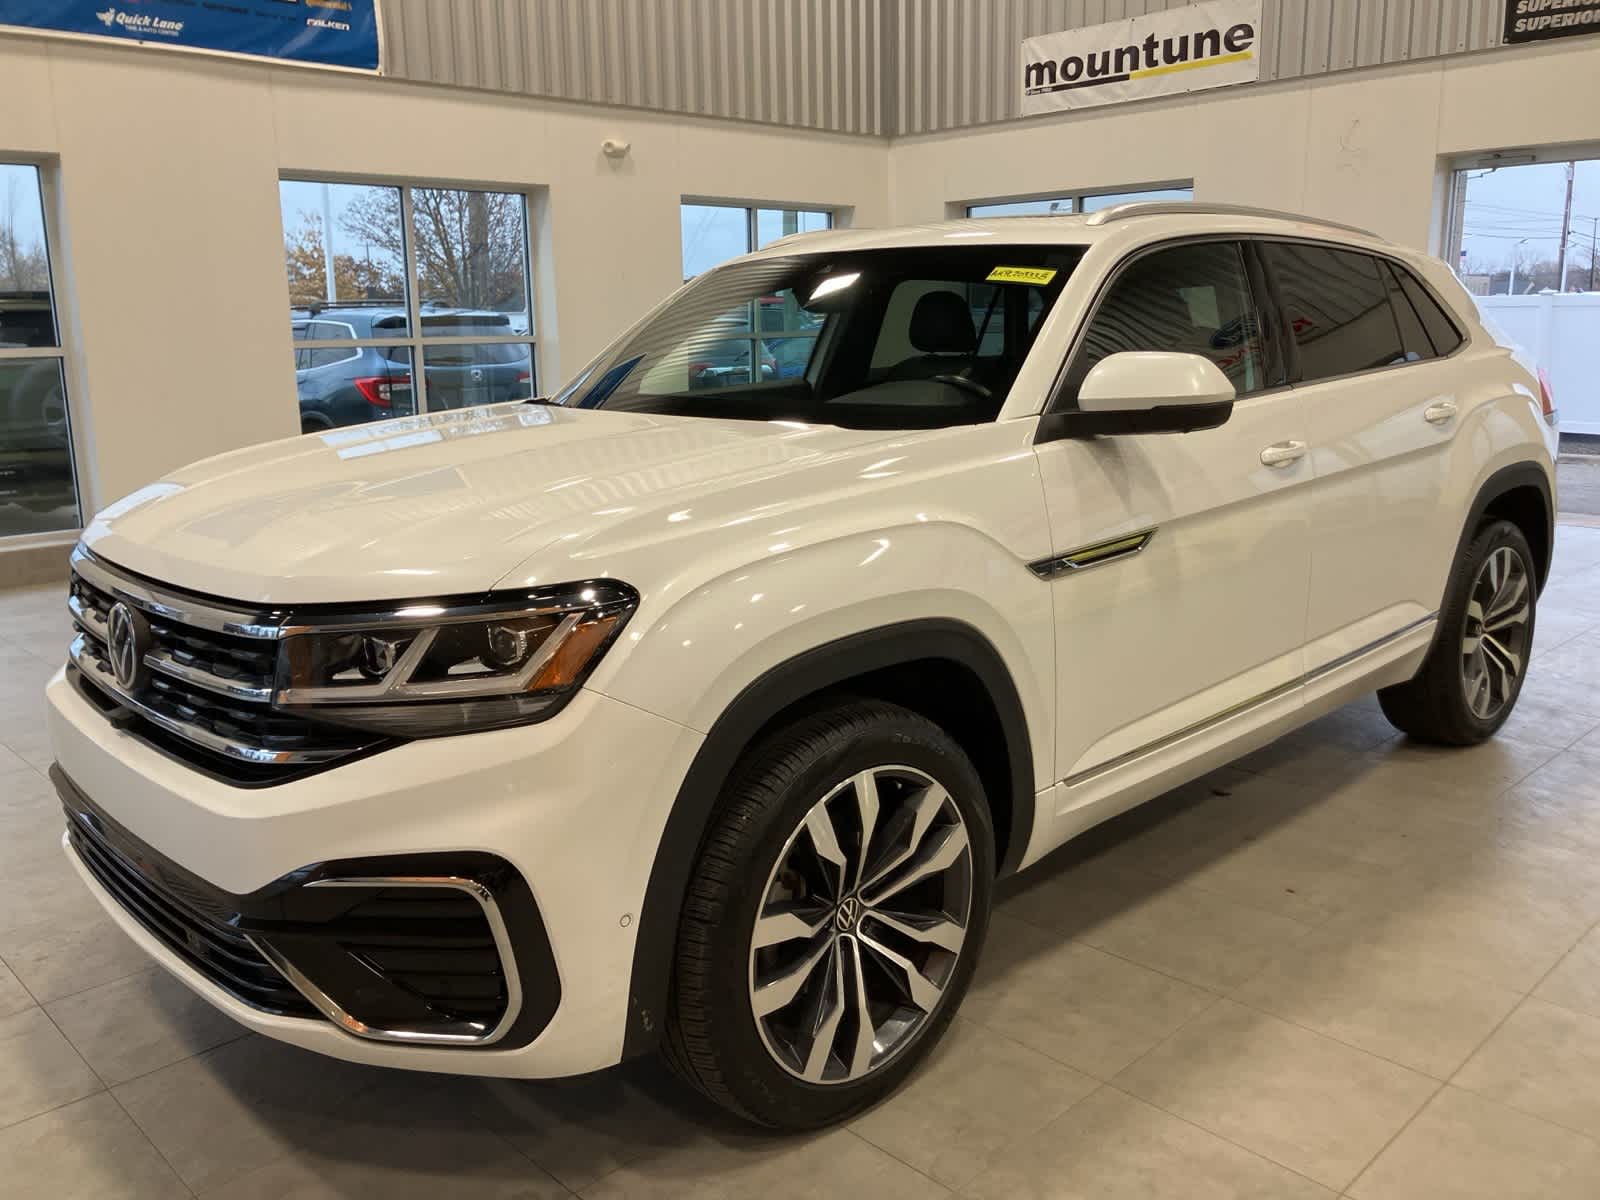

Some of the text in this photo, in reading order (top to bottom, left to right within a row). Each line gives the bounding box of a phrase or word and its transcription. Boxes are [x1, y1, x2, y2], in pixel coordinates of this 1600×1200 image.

[116, 11, 184, 31] Quick Lane
[1025, 22, 1255, 88] mountune
